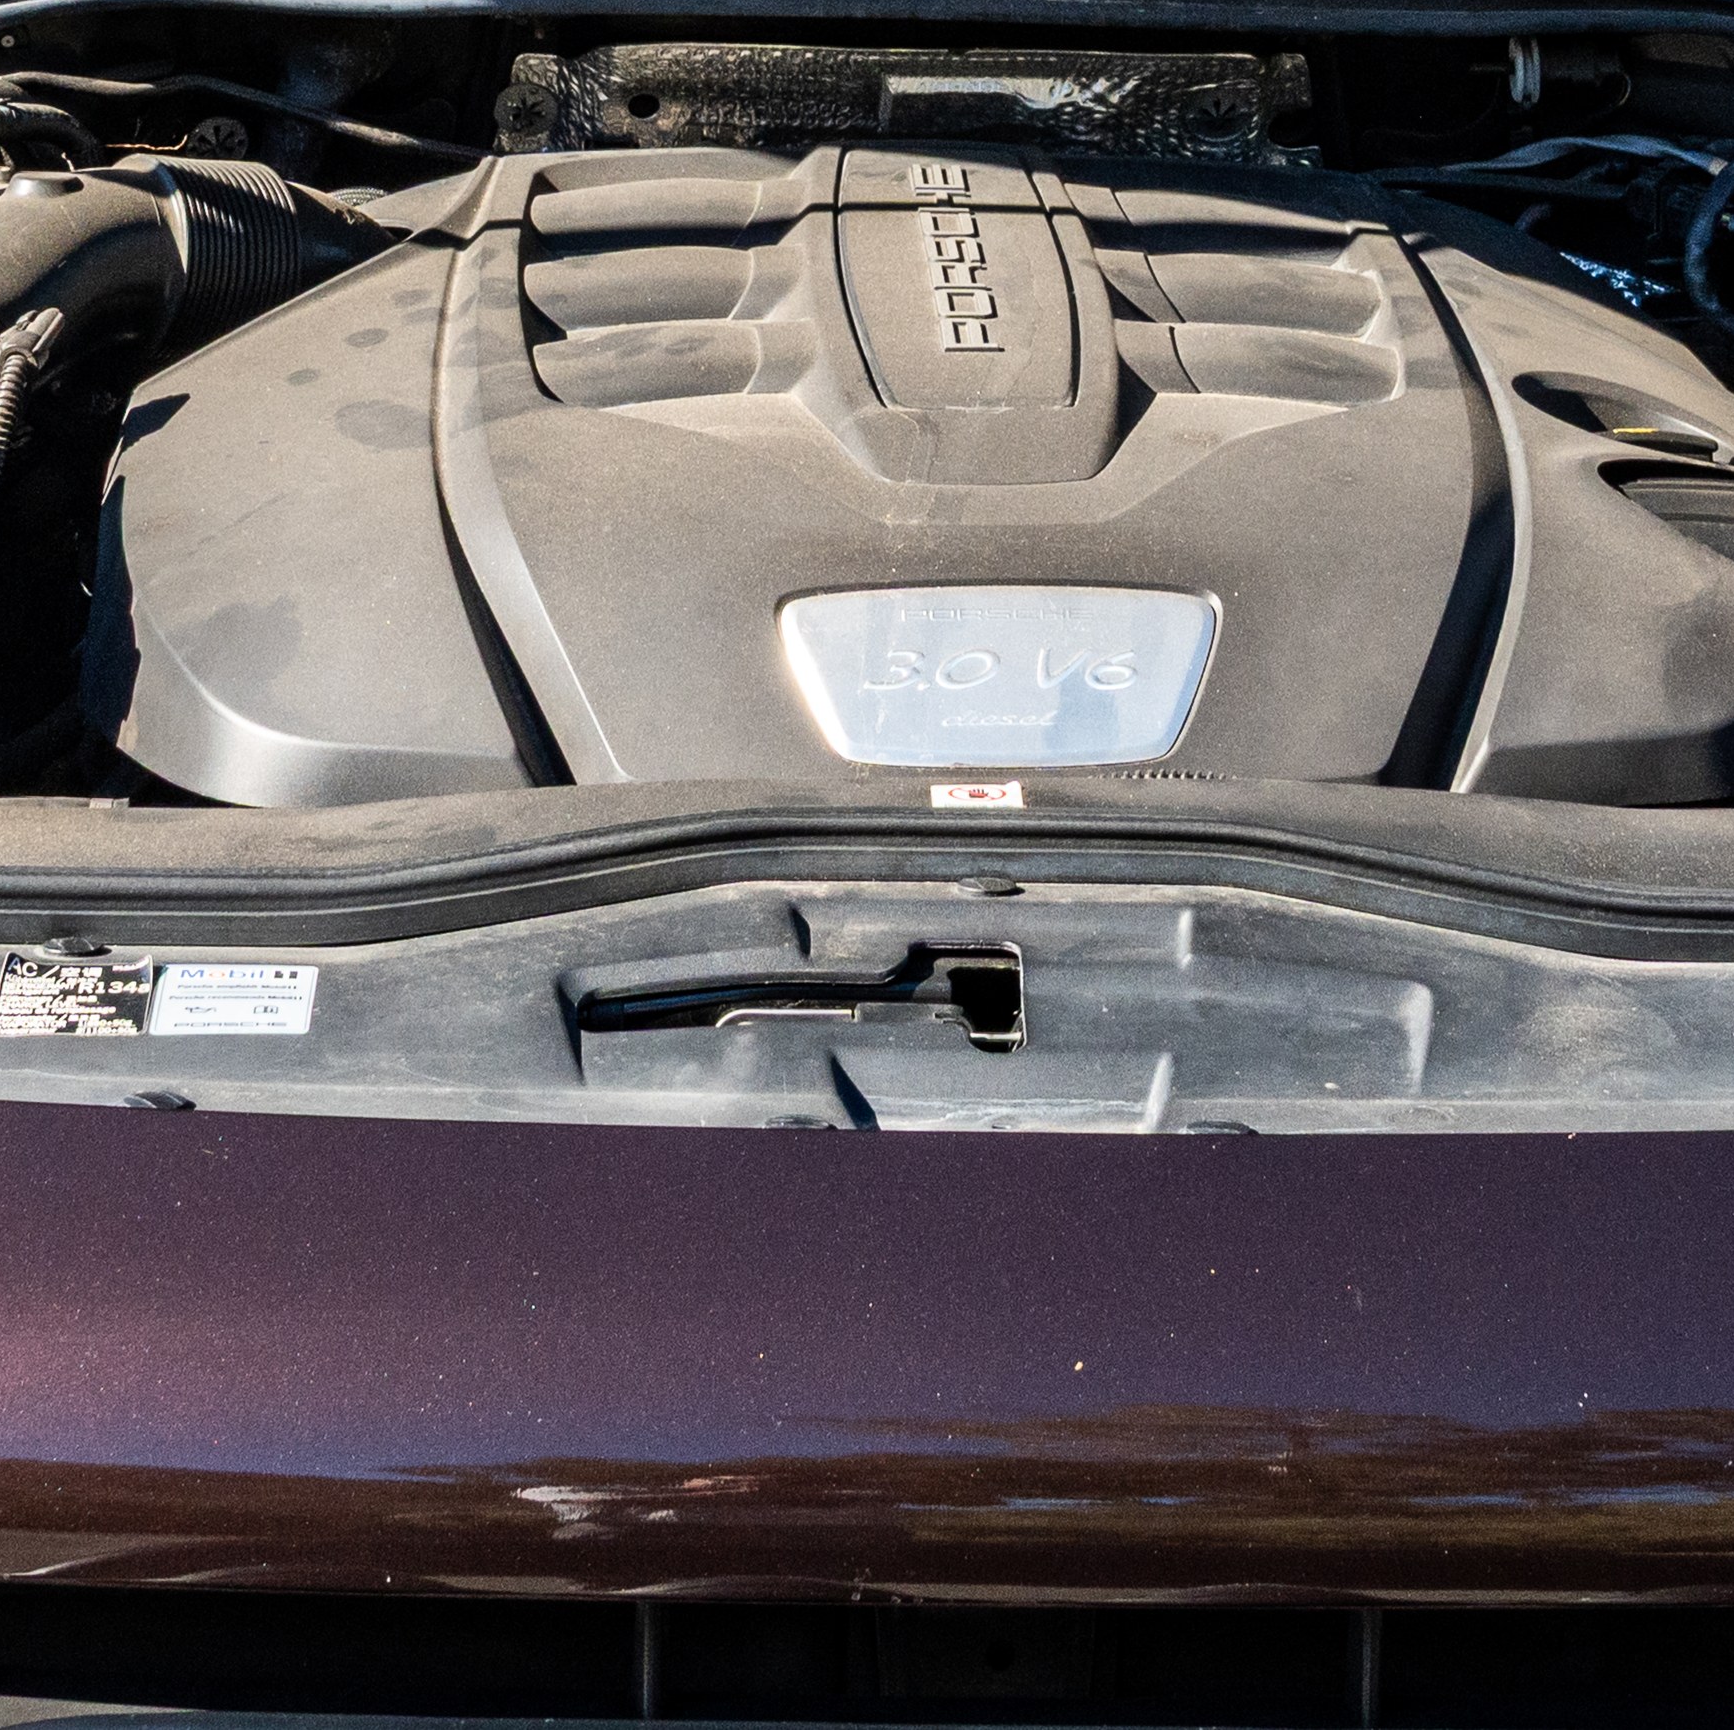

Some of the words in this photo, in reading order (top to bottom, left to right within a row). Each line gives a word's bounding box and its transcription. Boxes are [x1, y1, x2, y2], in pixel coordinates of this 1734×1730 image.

[910, 164, 1004, 352] PORSCHE
[901, 607, 1094, 621] PORSCHE
[863, 648, 1002, 691] 3.0
[1036, 647, 1139, 691] V6
[941, 710, 1059, 727] diesel
[8, 957, 38, 977] AC
[180, 969, 264, 979] Mobil
[78, 981, 151, 994] R134a
